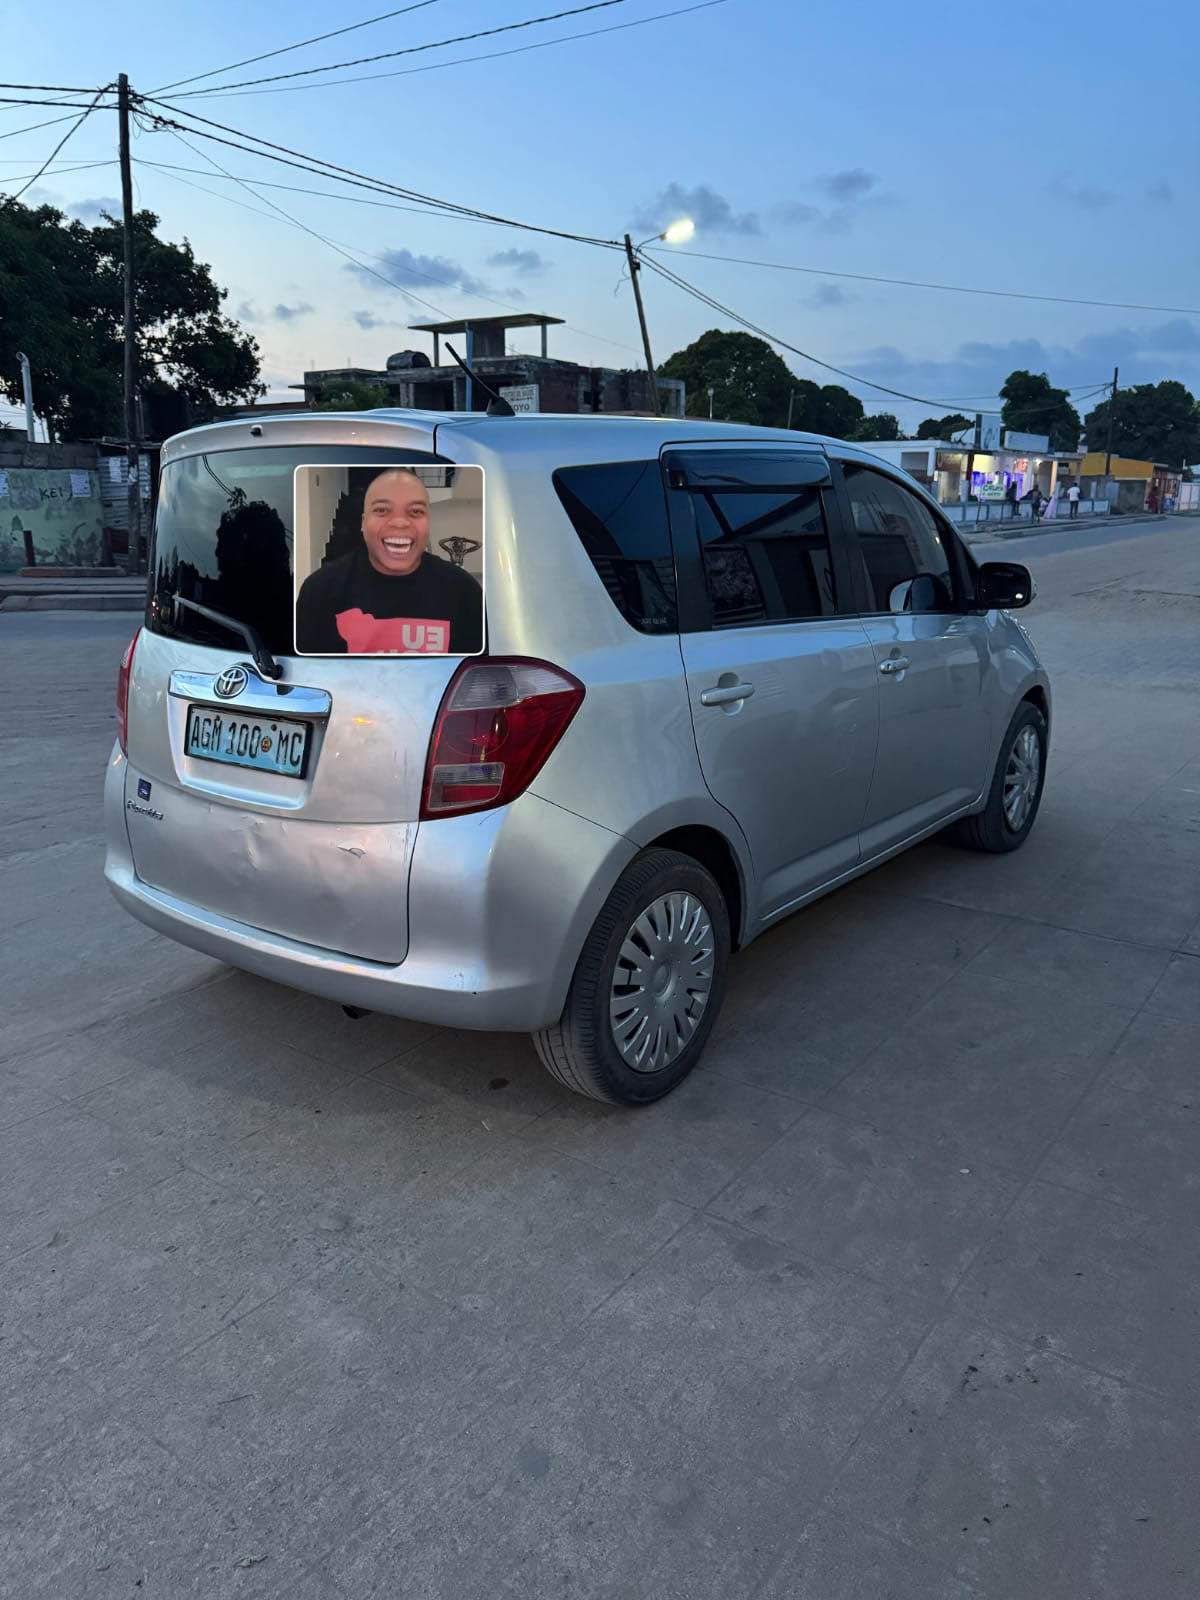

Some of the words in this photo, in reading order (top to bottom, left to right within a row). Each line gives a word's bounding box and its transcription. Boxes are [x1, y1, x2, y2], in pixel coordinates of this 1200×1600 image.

[190, 715, 223, 752] AGM
[225, 721, 261, 759] 100
[275, 729, 303, 768] MC
